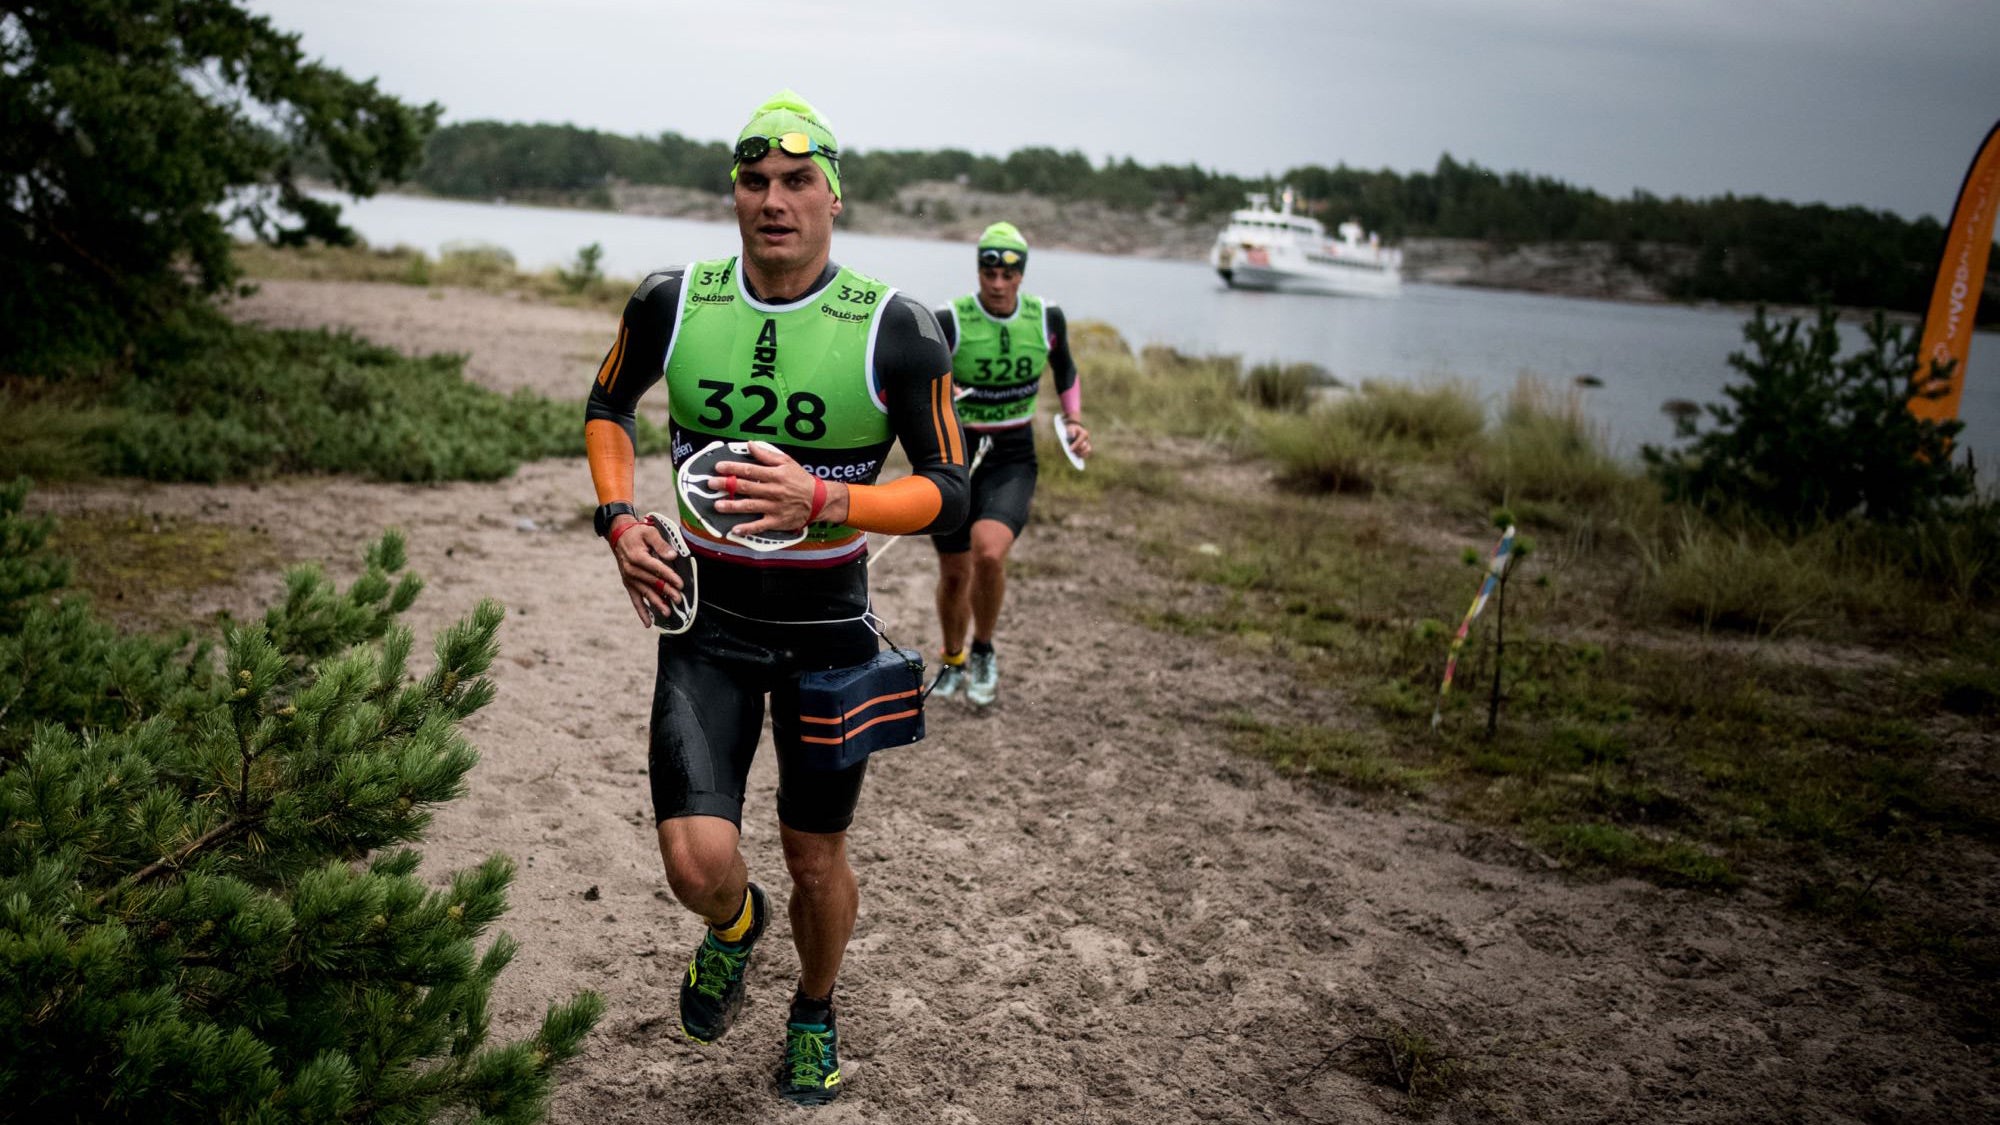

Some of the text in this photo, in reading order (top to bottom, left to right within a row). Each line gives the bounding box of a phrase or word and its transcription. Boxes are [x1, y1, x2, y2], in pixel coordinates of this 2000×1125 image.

[700, 269, 731, 285] 38
[838, 285, 877, 304] 328
[751, 319, 777, 380] ARK
[973, 357, 1032, 381] 328
[697, 379, 826, 441] 328
